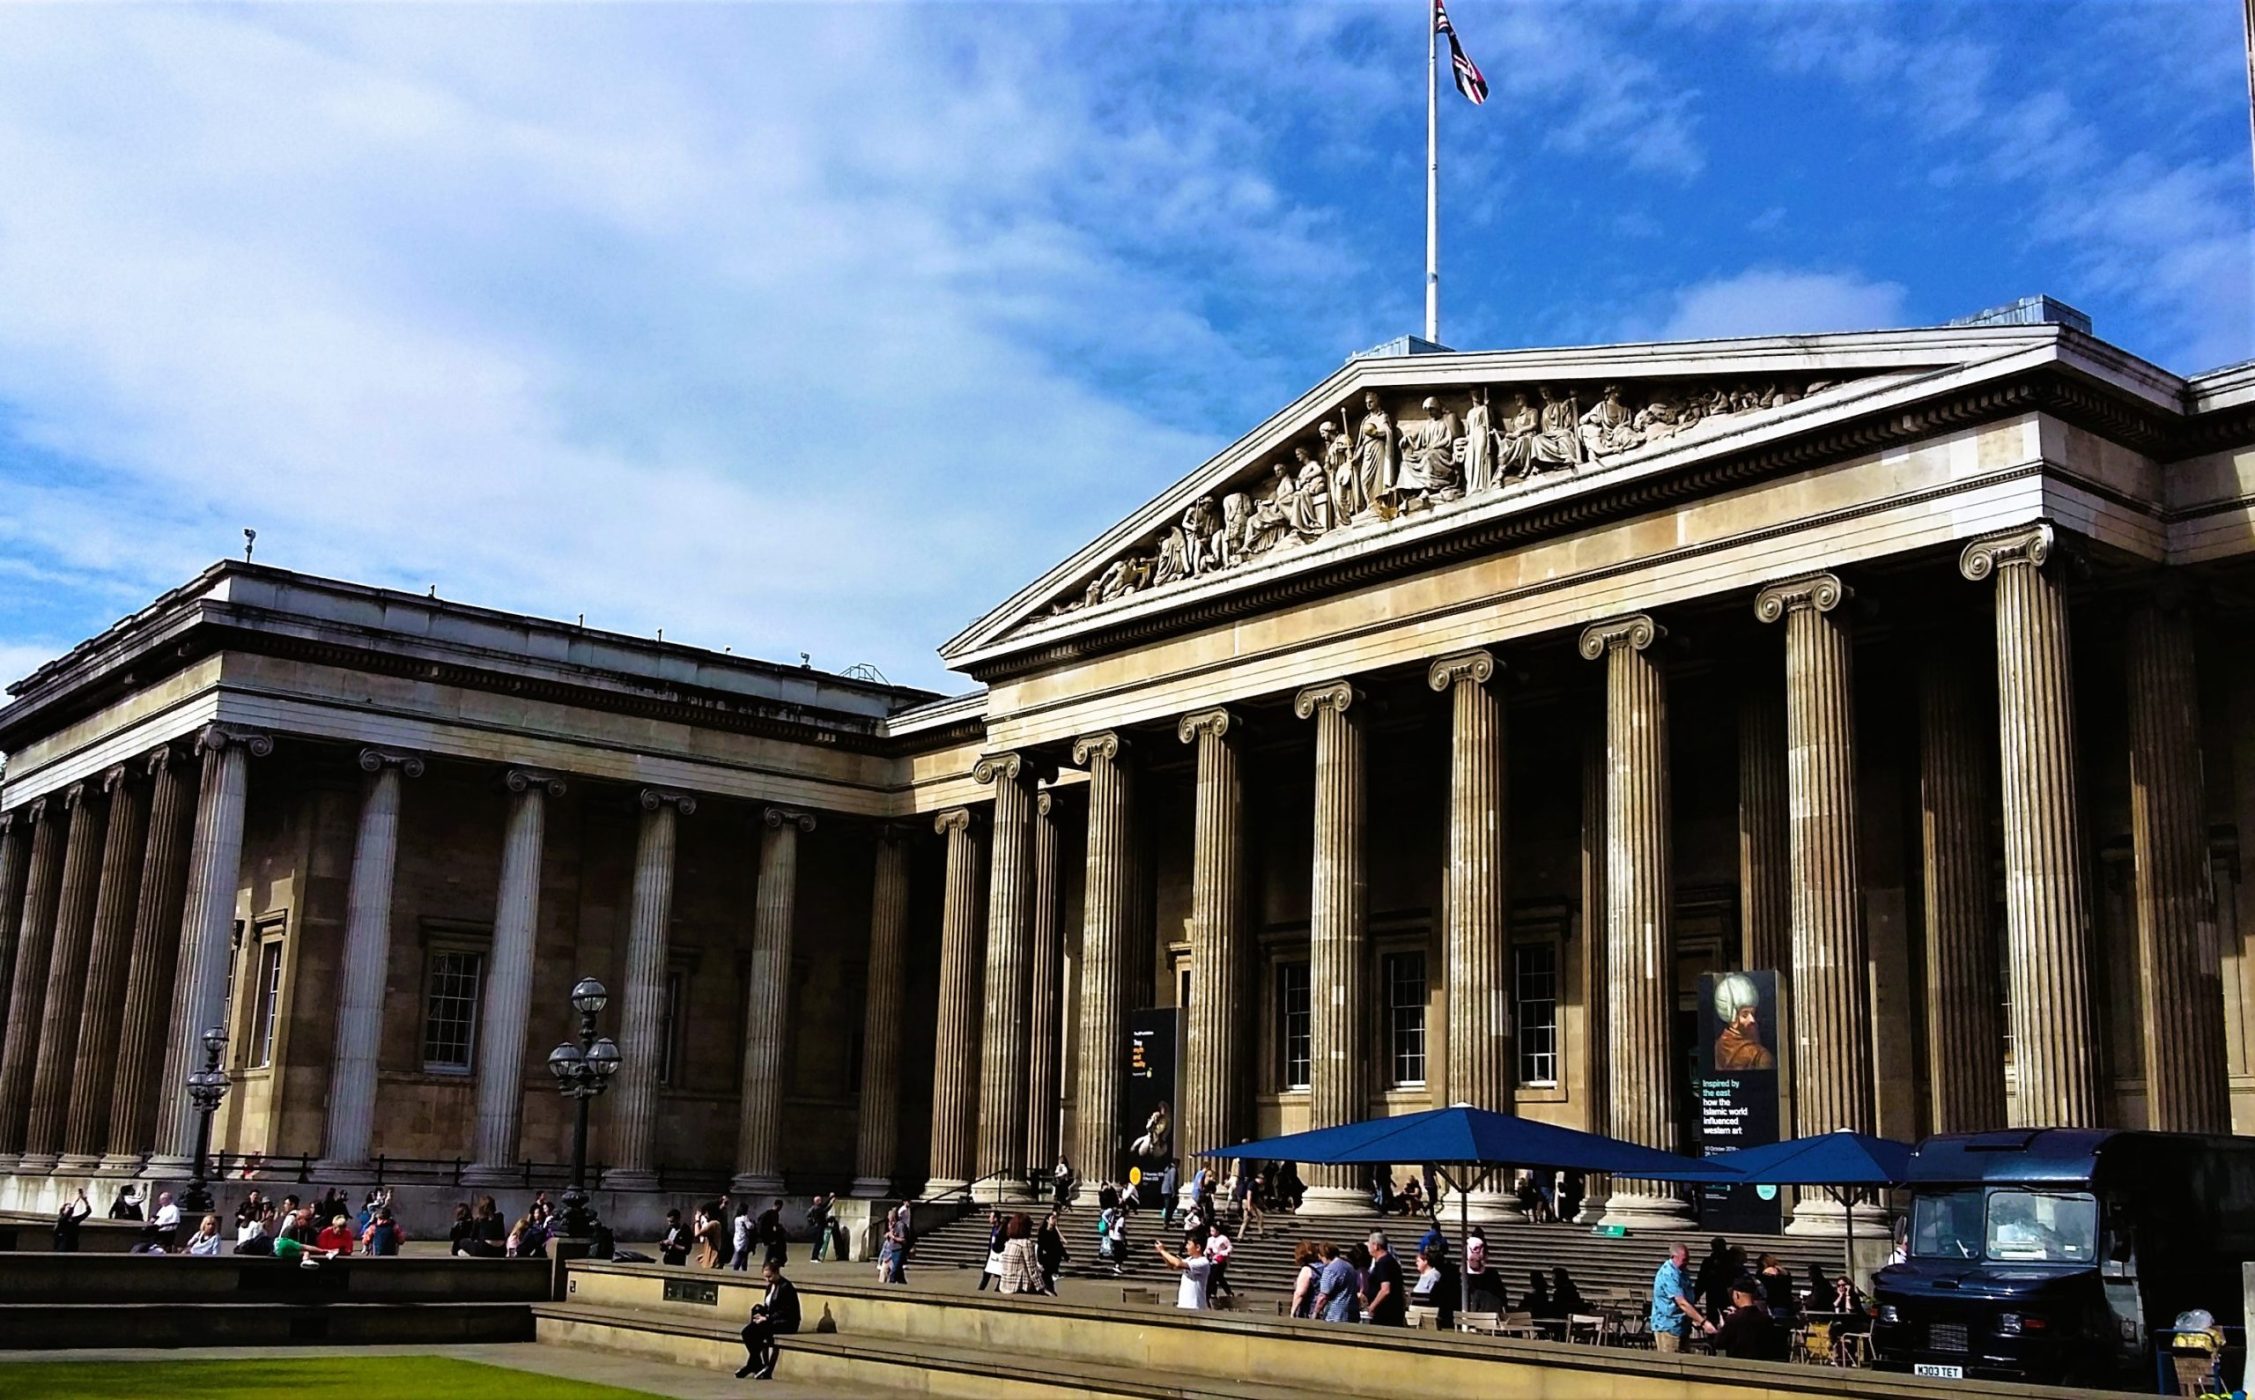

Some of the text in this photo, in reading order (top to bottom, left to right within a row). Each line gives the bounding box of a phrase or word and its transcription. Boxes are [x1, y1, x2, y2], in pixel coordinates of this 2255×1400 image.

[1702, 1079, 1740, 1089] Inspired by
[1702, 1089, 1731, 1097] the east
[1703, 1098, 1731, 1106] how the
[1703, 1107, 1748, 1116] Islamic world
[1703, 1116, 1739, 1125] influenced
[1703, 1126, 1743, 1135] western art
[1941, 1367, 1958, 1377] TET
